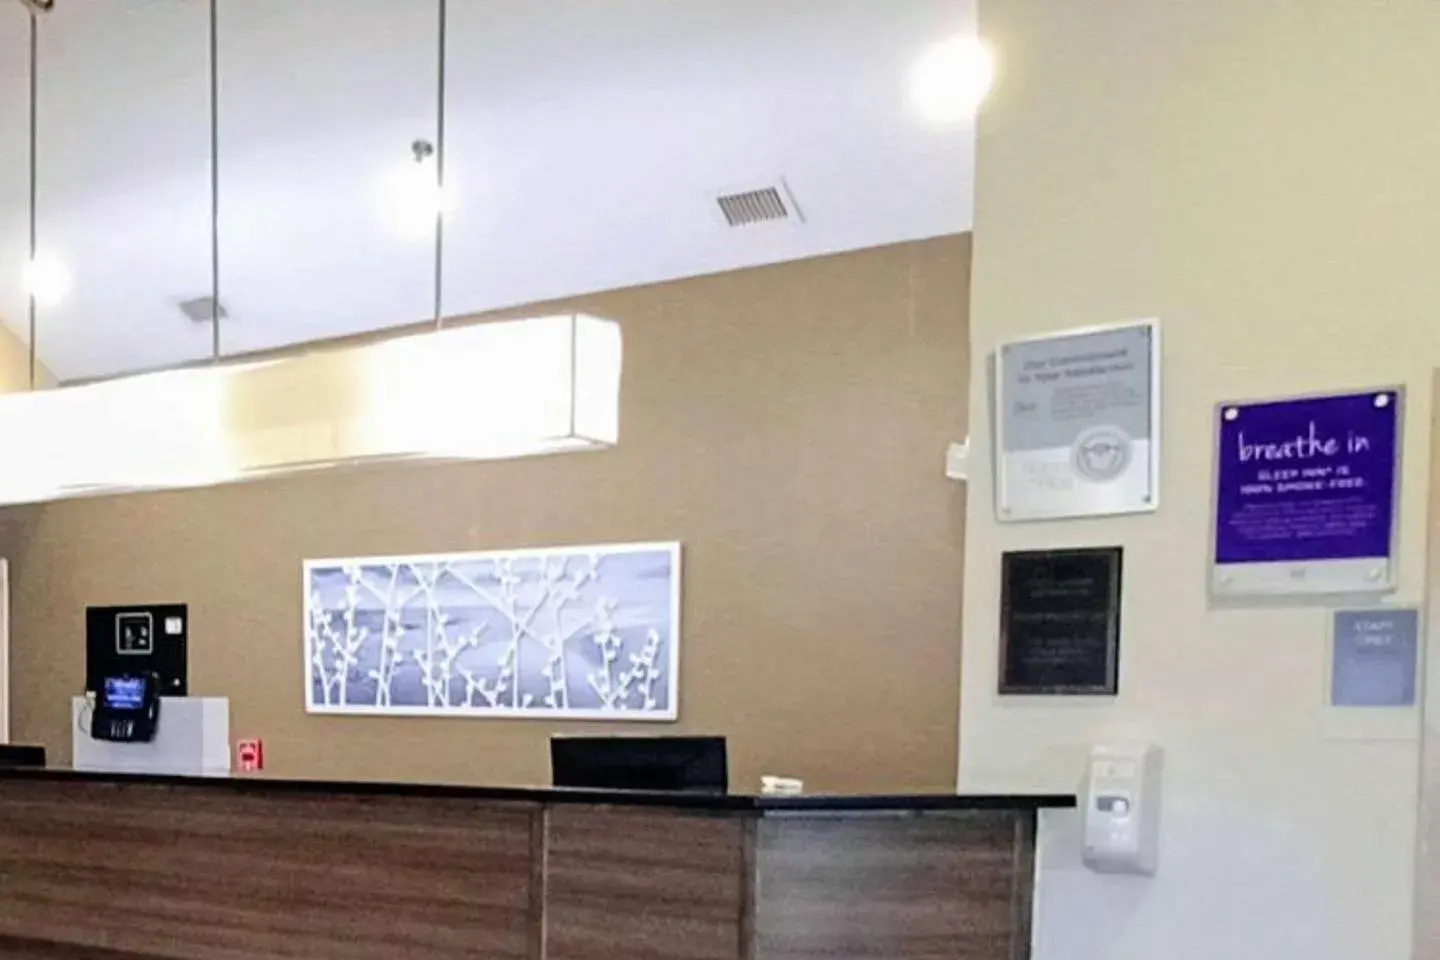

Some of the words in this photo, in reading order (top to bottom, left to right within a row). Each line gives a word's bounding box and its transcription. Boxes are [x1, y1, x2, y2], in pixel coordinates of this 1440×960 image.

[1239, 421, 1340, 461] breathe
[1347, 429, 1370, 454] in
[1257, 468, 1299, 481] SLEEP
